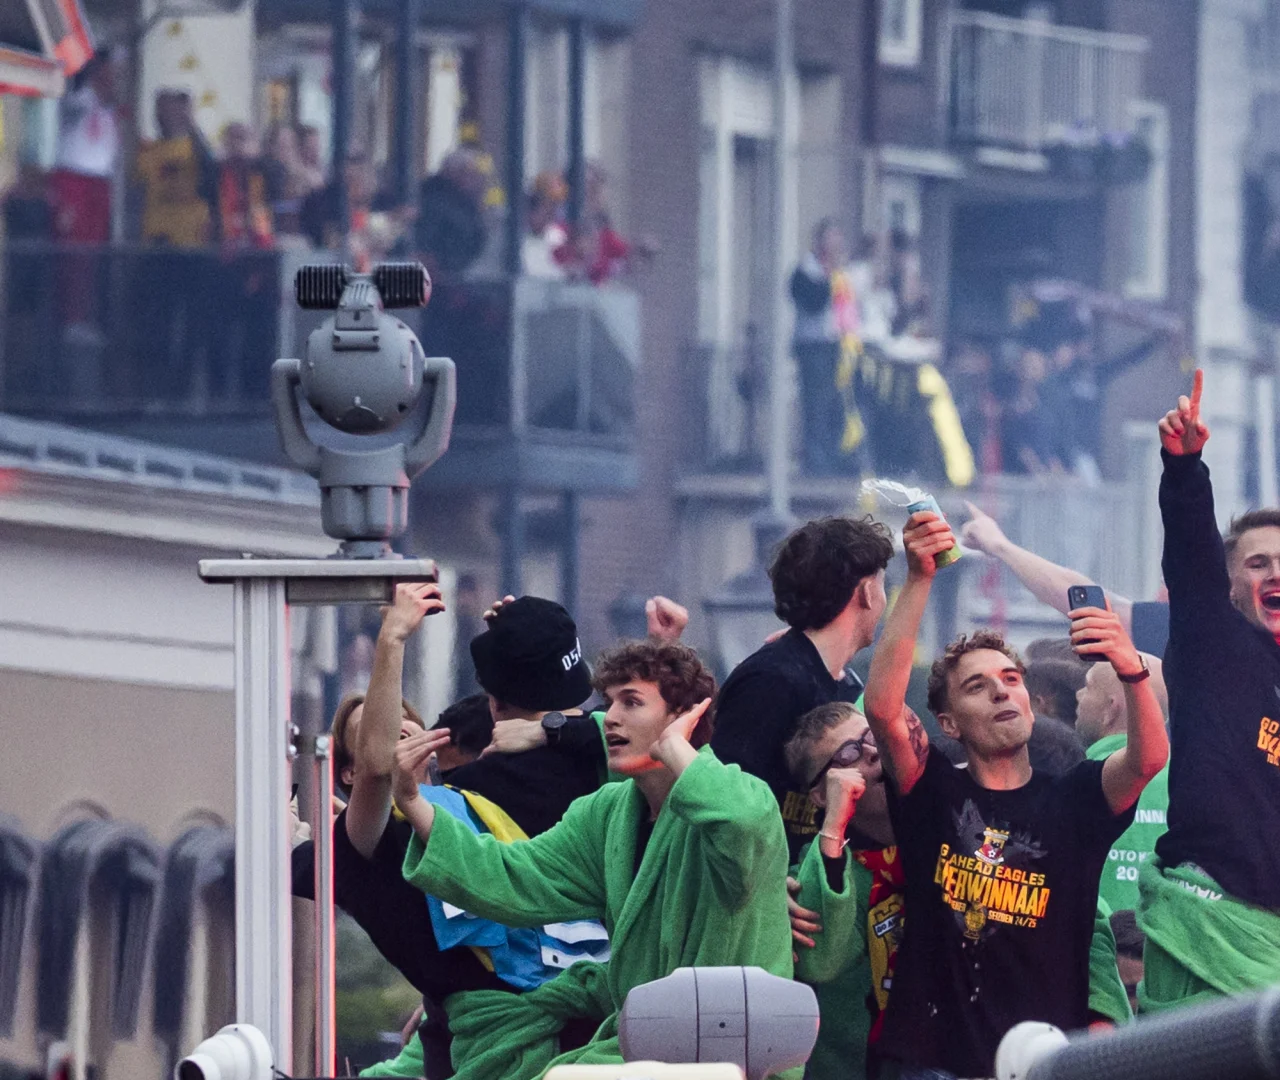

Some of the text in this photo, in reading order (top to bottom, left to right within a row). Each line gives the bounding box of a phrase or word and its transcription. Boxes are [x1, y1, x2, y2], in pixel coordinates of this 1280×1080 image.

[1260, 717, 1280, 734] GO
[1109, 849, 1137, 862] OTO
[941, 843, 1045, 886] G AHEAD EAGLES
